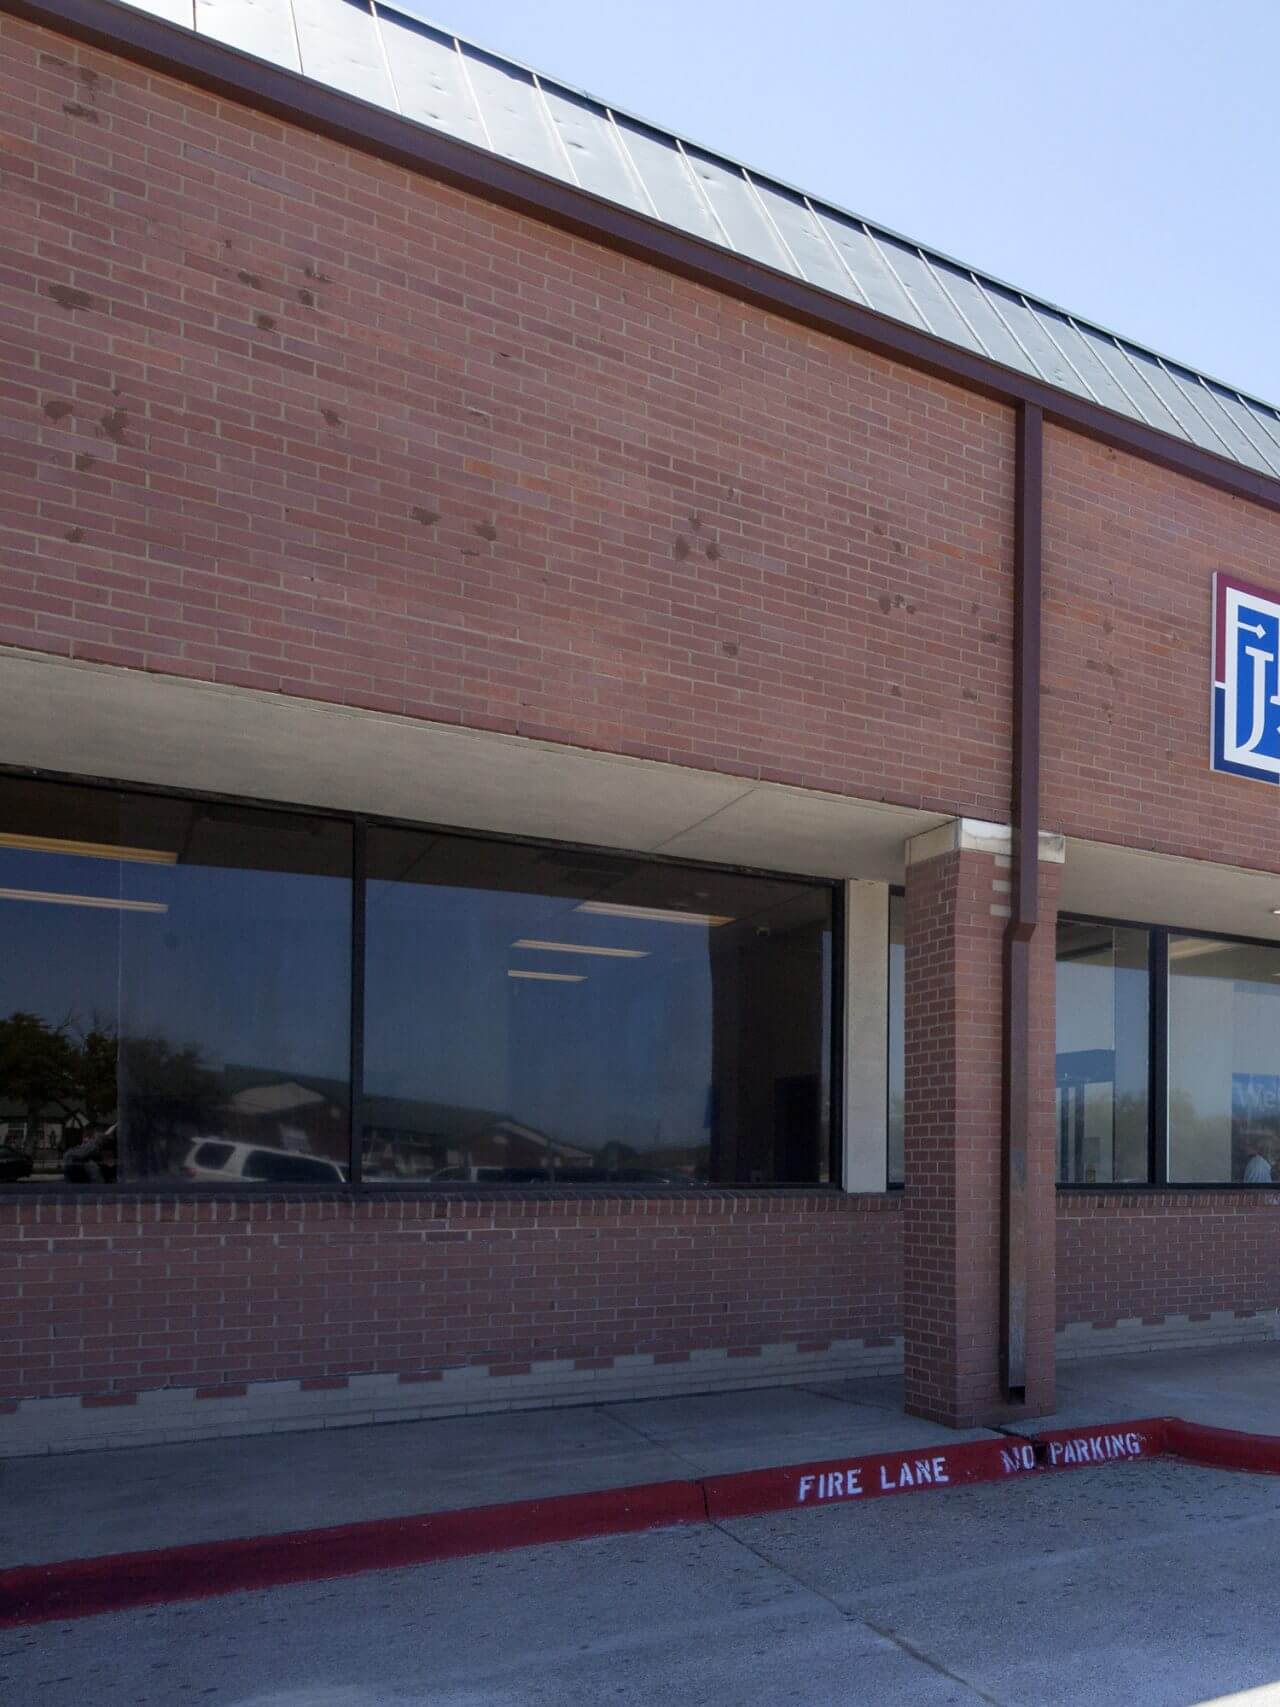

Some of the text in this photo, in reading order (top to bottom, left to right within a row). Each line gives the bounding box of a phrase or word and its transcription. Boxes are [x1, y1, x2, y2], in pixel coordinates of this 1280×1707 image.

[1000, 1432, 1141, 1473] NO PARKING
[798, 1456, 950, 1502] FIRE LANE
